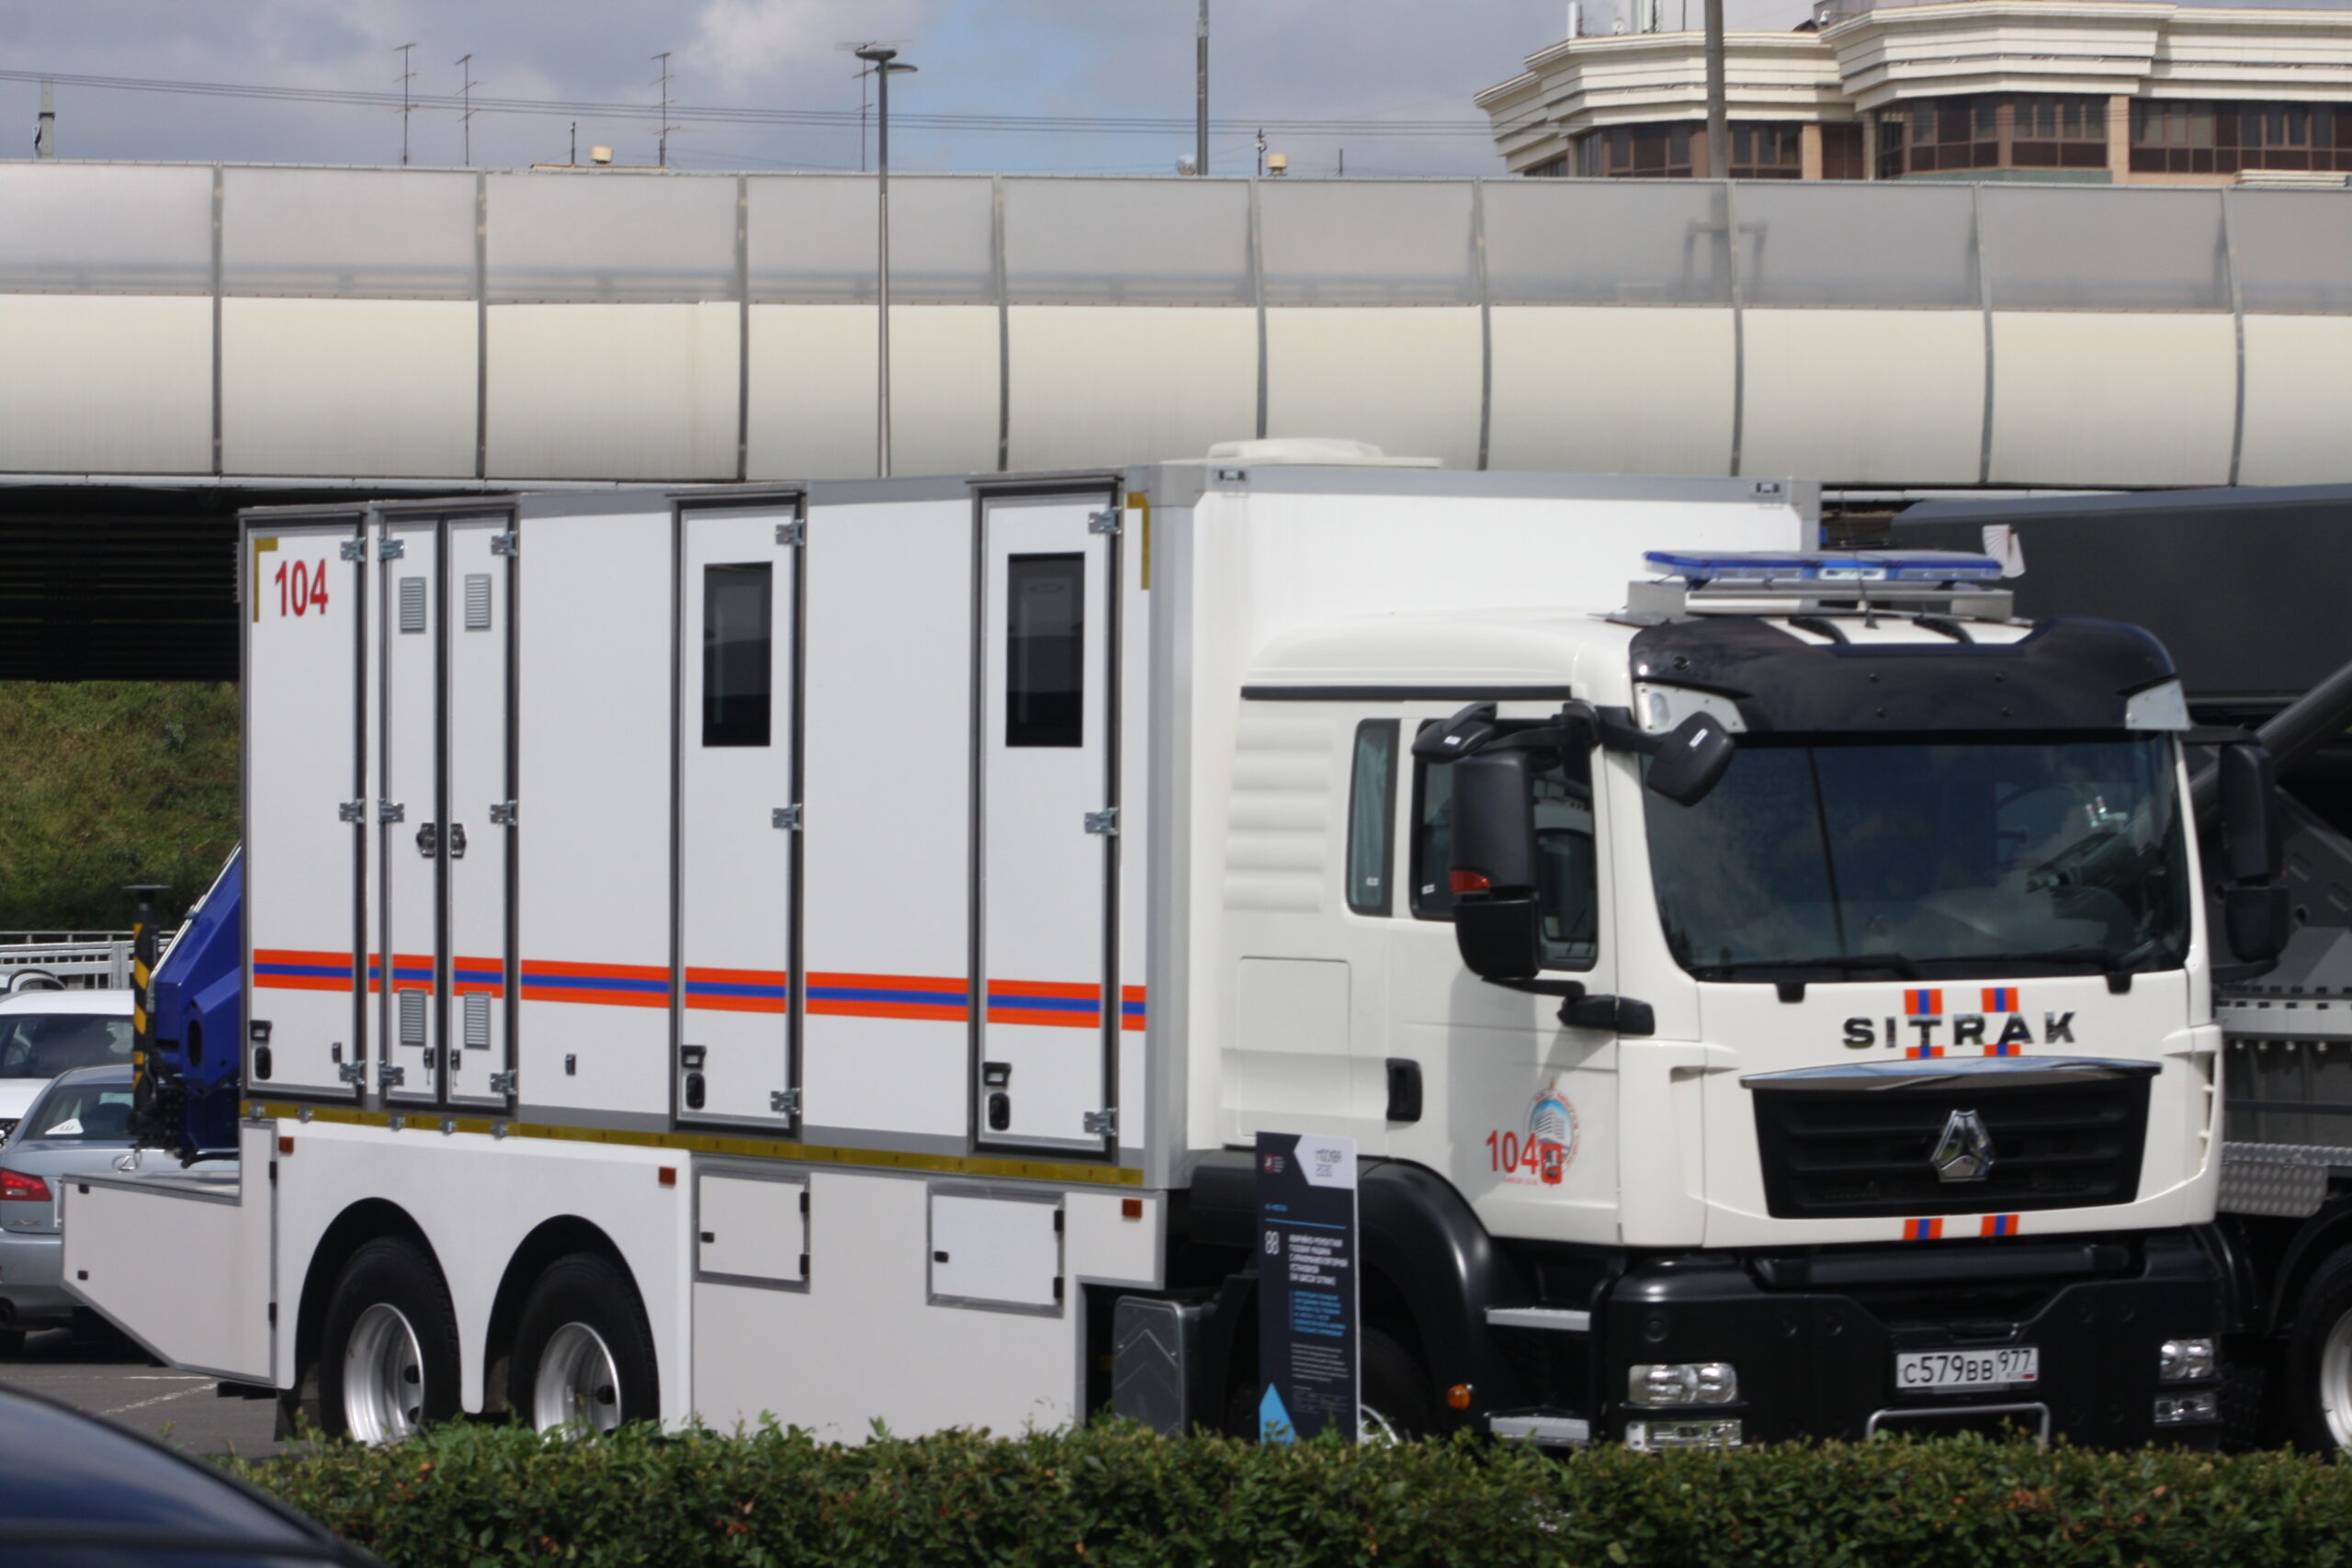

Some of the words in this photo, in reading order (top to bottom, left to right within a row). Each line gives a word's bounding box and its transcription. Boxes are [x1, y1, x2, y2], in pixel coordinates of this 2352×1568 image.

[275, 558, 329, 616] 104
[1843, 1011, 2075, 1049] SITRAK
[1485, 1129, 1540, 1175] 104
